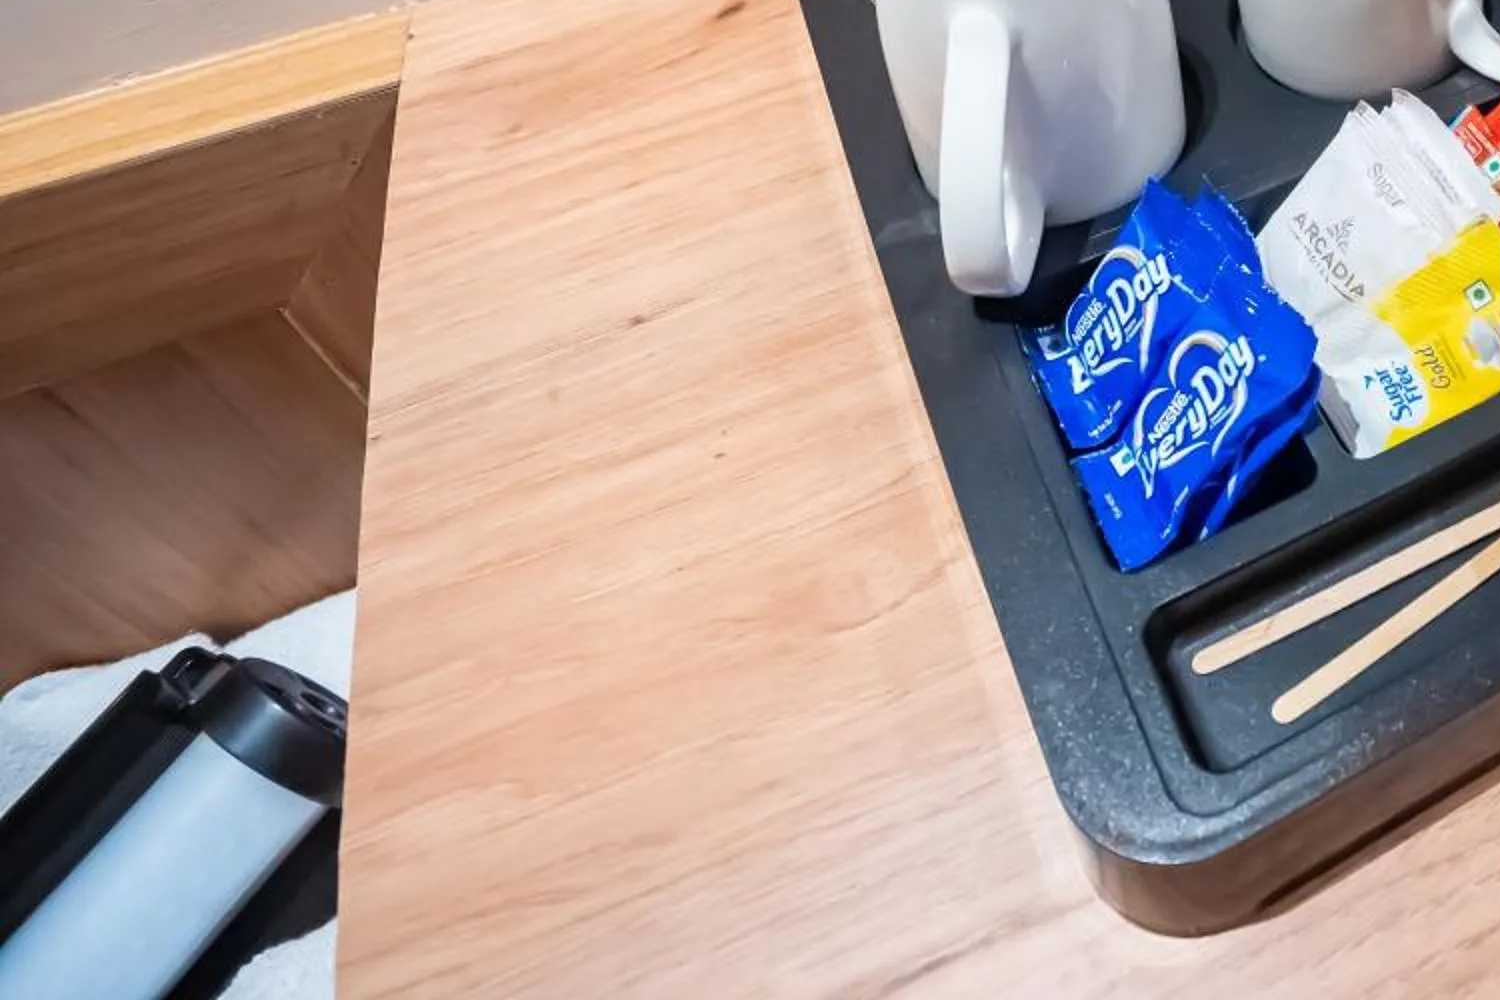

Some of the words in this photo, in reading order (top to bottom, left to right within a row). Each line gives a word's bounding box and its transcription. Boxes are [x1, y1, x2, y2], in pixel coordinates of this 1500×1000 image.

[1292, 211, 1366, 298] ARCADIA
[1394, 364, 1423, 404] Free
[1413, 343, 1452, 390] Gold
[1374, 367, 1413, 422] Sugar
